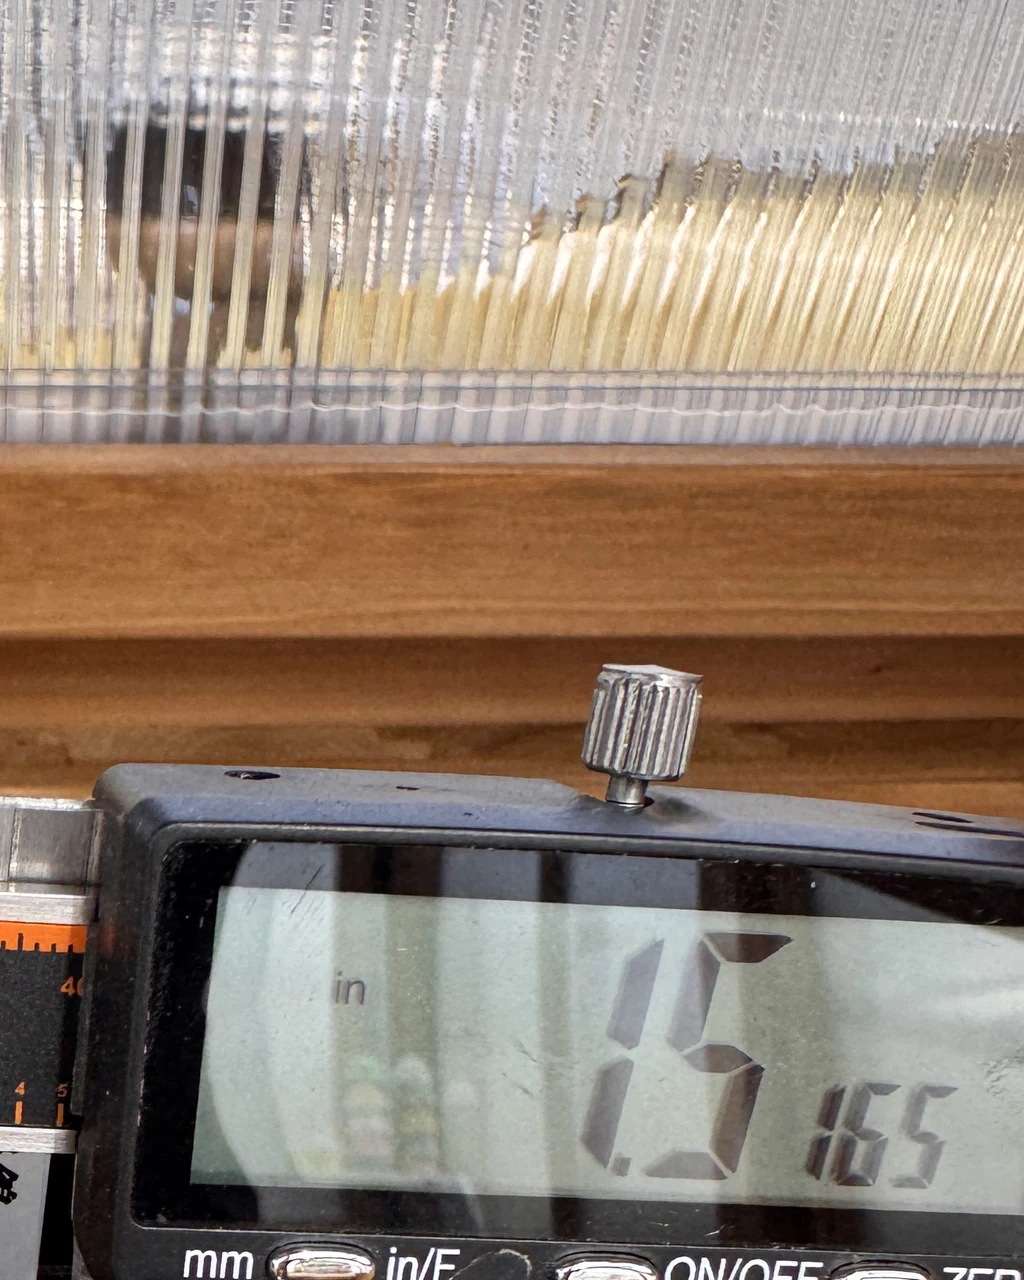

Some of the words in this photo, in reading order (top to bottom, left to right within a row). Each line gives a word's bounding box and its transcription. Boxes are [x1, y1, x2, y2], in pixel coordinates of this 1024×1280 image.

[334, 970, 366, 1006] in
[14, 1081, 25, 1096] 4
[57, 1083, 68, 1098] 5
[183, 1249, 254, 1279] mm
